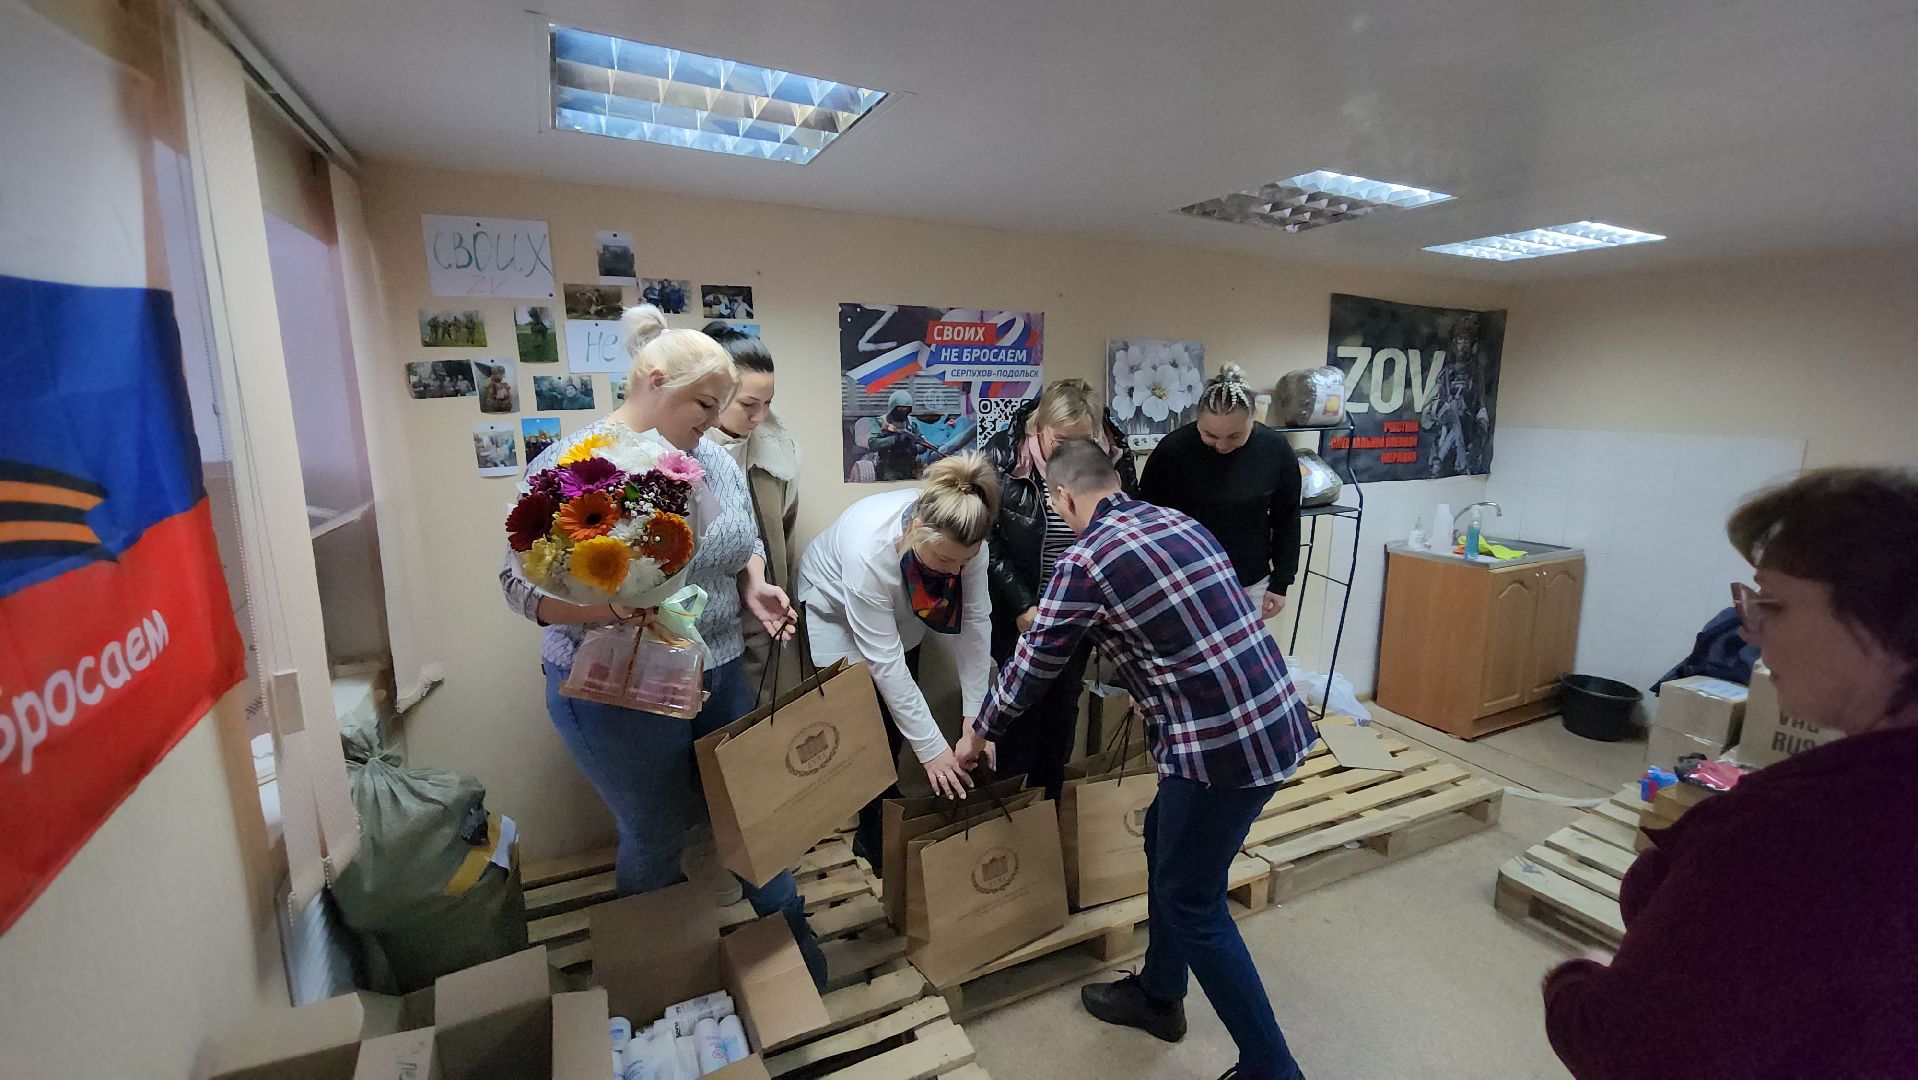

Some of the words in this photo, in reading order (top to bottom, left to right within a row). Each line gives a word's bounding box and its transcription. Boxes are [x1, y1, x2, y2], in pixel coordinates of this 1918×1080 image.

[932, 325, 985, 342] СВОИХ
[940, 347, 960, 362] НЕ
[962, 348, 1028, 363] БРОСАЕМ
[950, 368, 1040, 379] СЕРПУХОВ-ПОДОЛЬСК
[1336, 346, 1446, 414] ZOV
